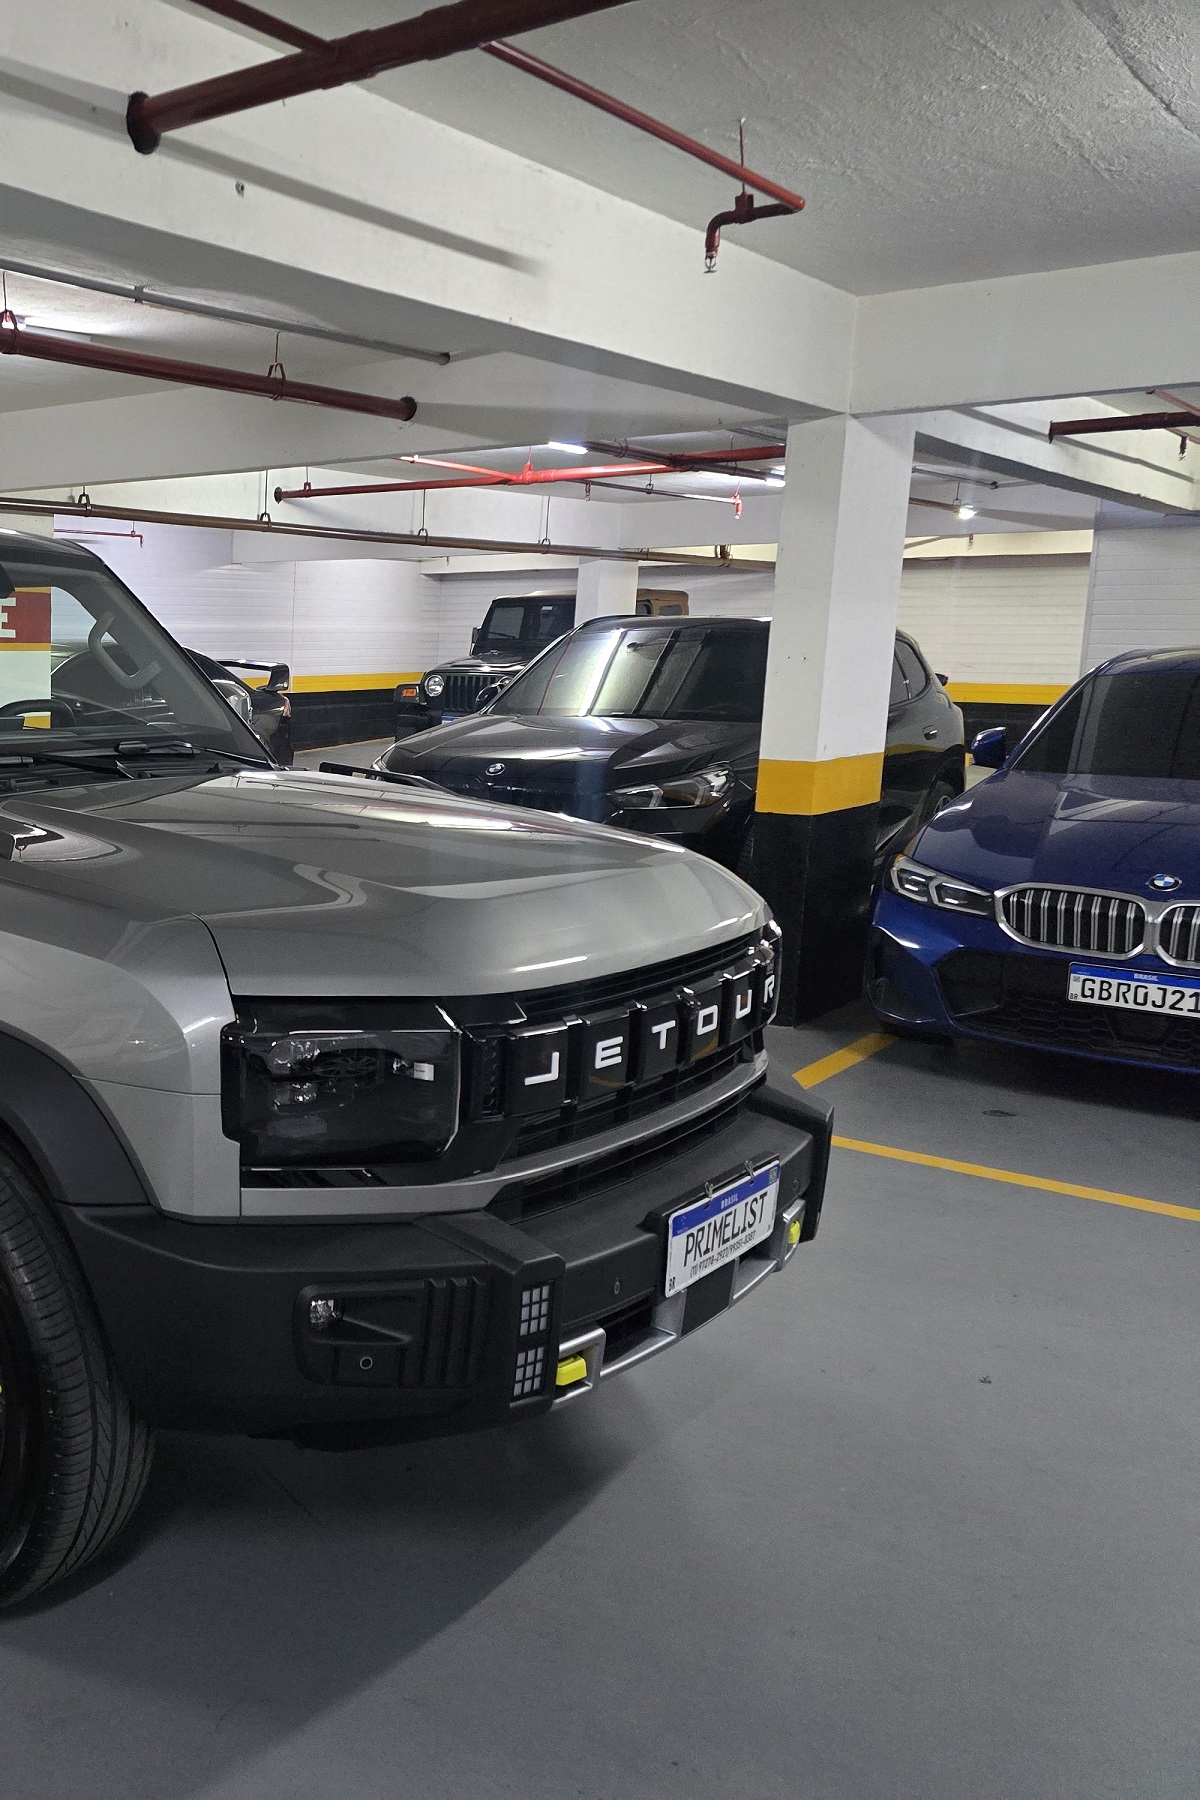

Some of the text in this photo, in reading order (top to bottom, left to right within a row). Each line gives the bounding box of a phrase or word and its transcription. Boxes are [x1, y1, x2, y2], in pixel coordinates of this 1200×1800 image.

[1133, 973, 1158, 981] BRASIL
[524, 974, 775, 1085] JETOUR
[720, 1194, 739, 1209] BRASIL
[684, 1191, 768, 1267] PRIMELIST
